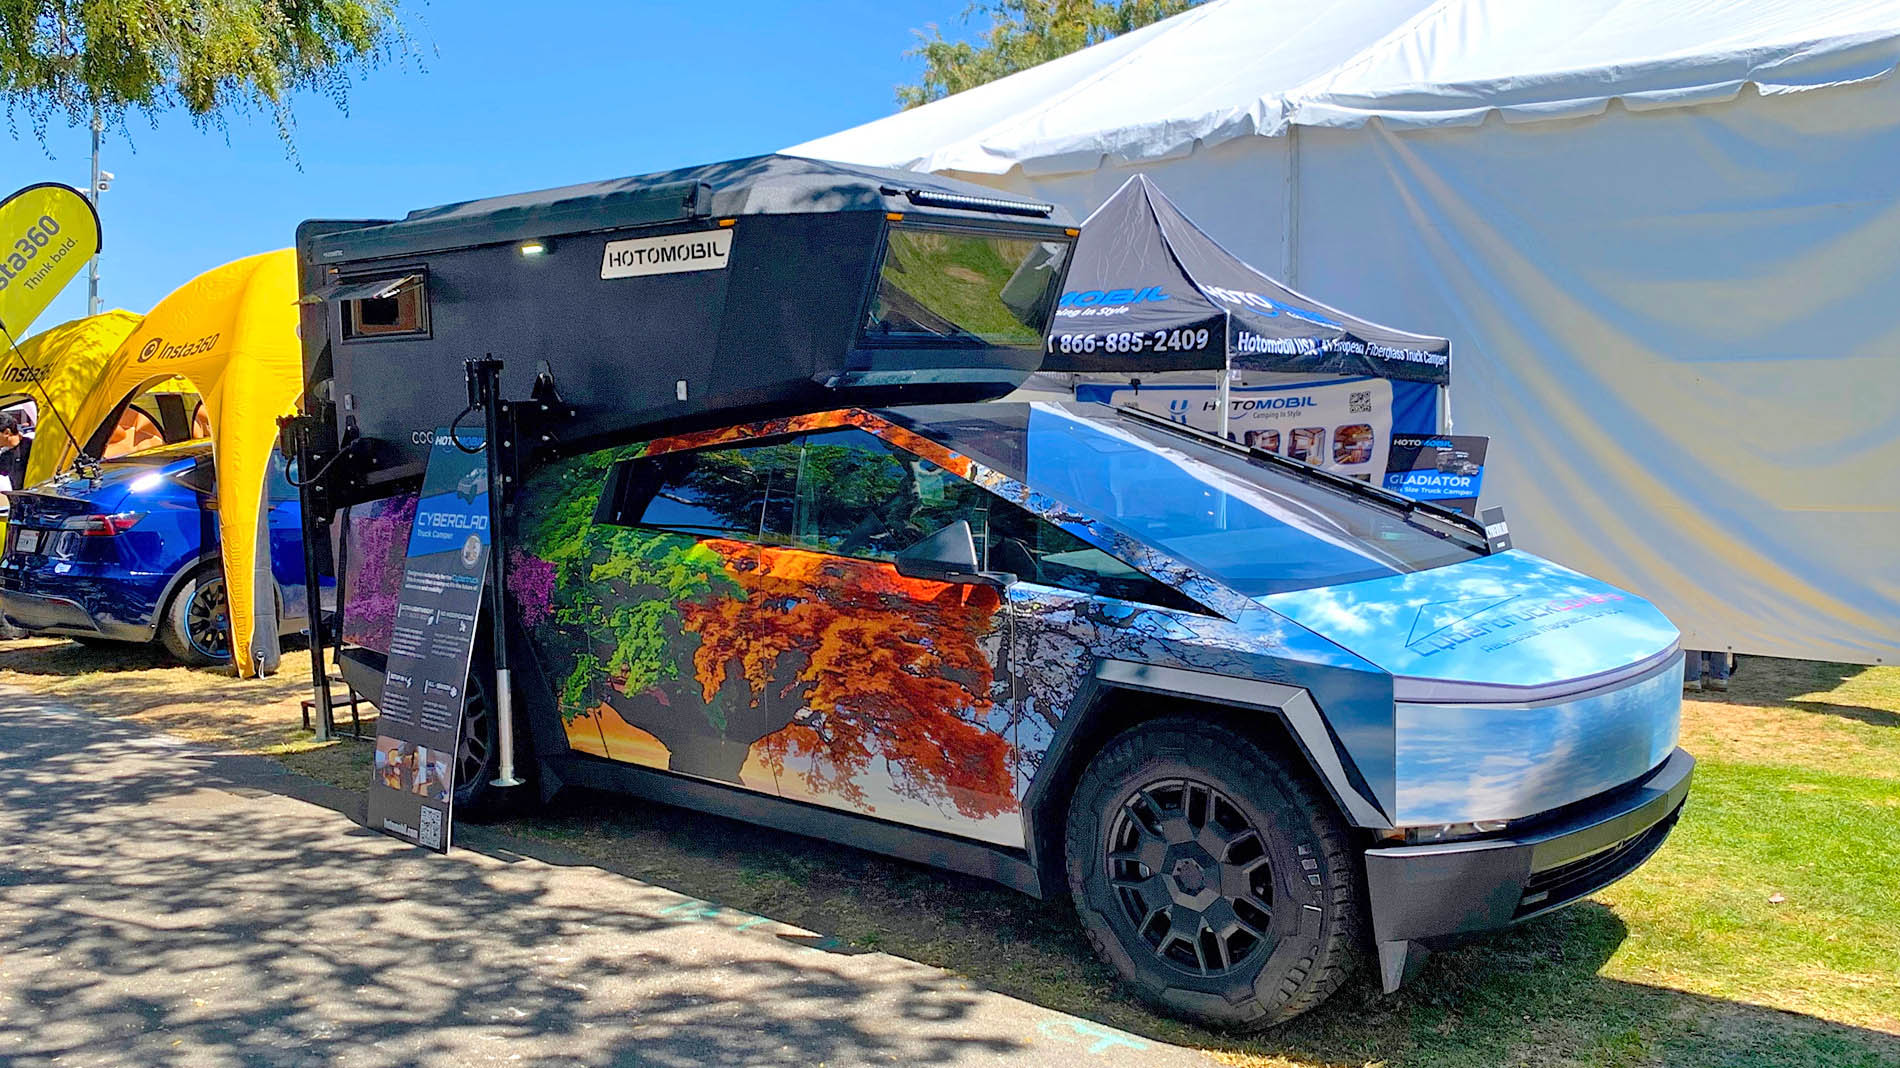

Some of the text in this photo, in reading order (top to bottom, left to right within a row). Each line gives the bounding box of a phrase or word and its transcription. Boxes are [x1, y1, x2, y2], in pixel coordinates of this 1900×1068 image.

[609, 241, 725, 267] HOTOMOBIL
[23, 237, 79, 290] Think bold.
[1096, 305, 1129, 317] Style
[157, 332, 220, 360] Insta360
[1060, 328, 1209, 354] 866-885-2409
[1238, 331, 1297, 355] Hotomobil
[1294, 338, 1318, 356] USA
[1365, 341, 1406, 362] Fiberglass
[1202, 396, 1318, 412] HTOMOBIL
[1252, 410, 1277, 420] Camping
[1393, 438, 1454, 449] HOTOMOBIL
[1389, 474, 1471, 488] GLADIATOR
[1404, 486, 1419, 494] Size
[1421, 487, 1442, 495] Truck
[1443, 488, 1473, 497] Camper
[417, 511, 488, 530] CYBERGLAD
